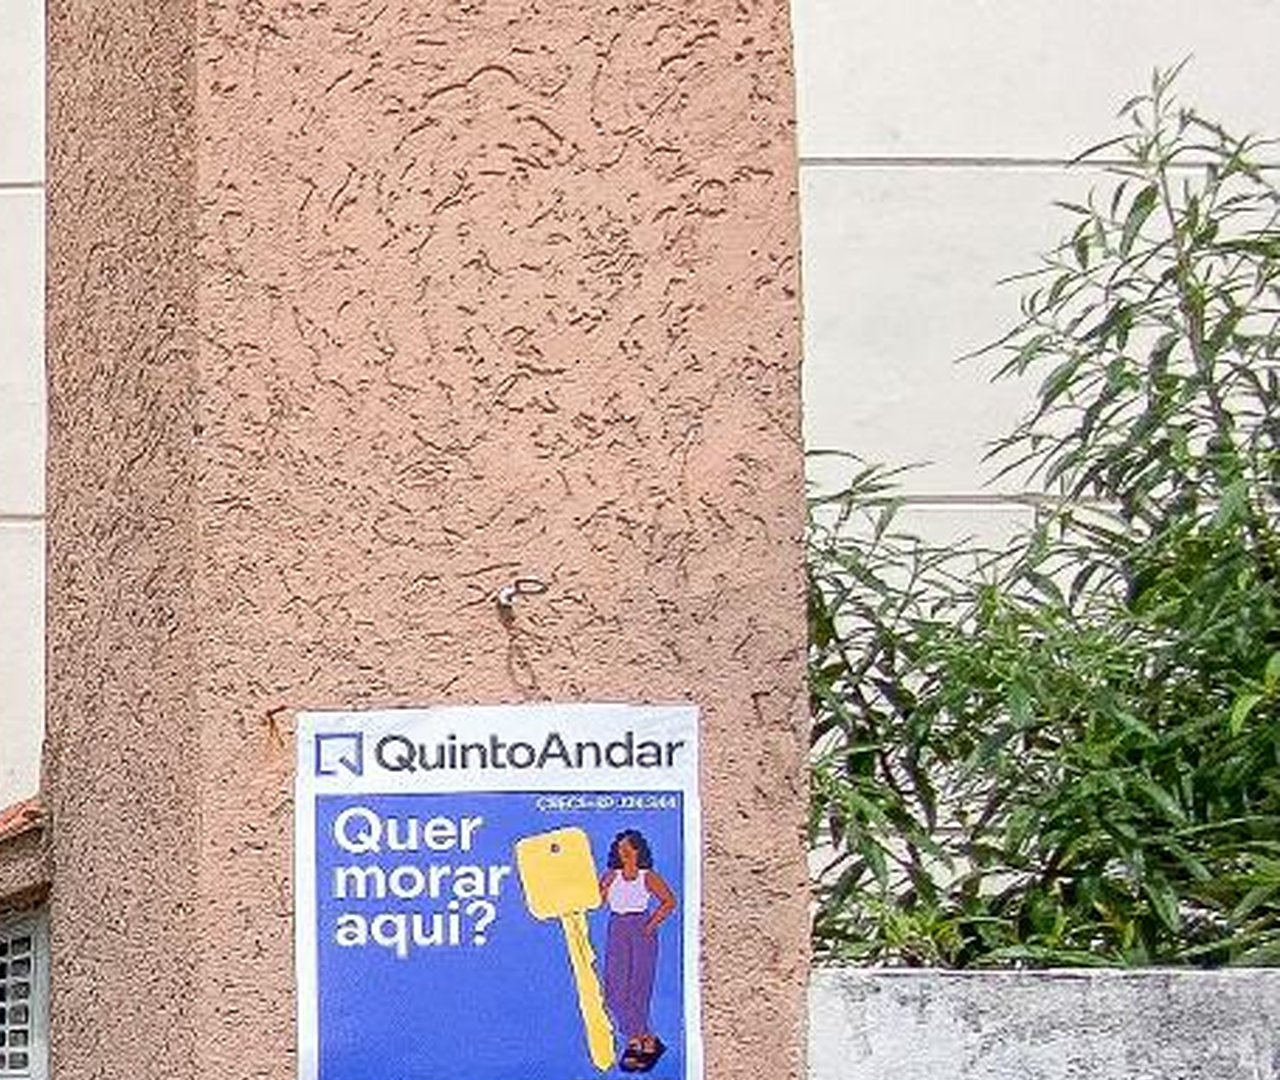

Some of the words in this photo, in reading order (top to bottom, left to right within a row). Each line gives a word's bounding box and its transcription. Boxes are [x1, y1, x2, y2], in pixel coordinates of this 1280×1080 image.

[374, 731, 685, 773] QuintoAndar
[333, 806, 483, 854] Quer
[333, 865, 510, 900] morar
[335, 900, 497, 957] aqui?
